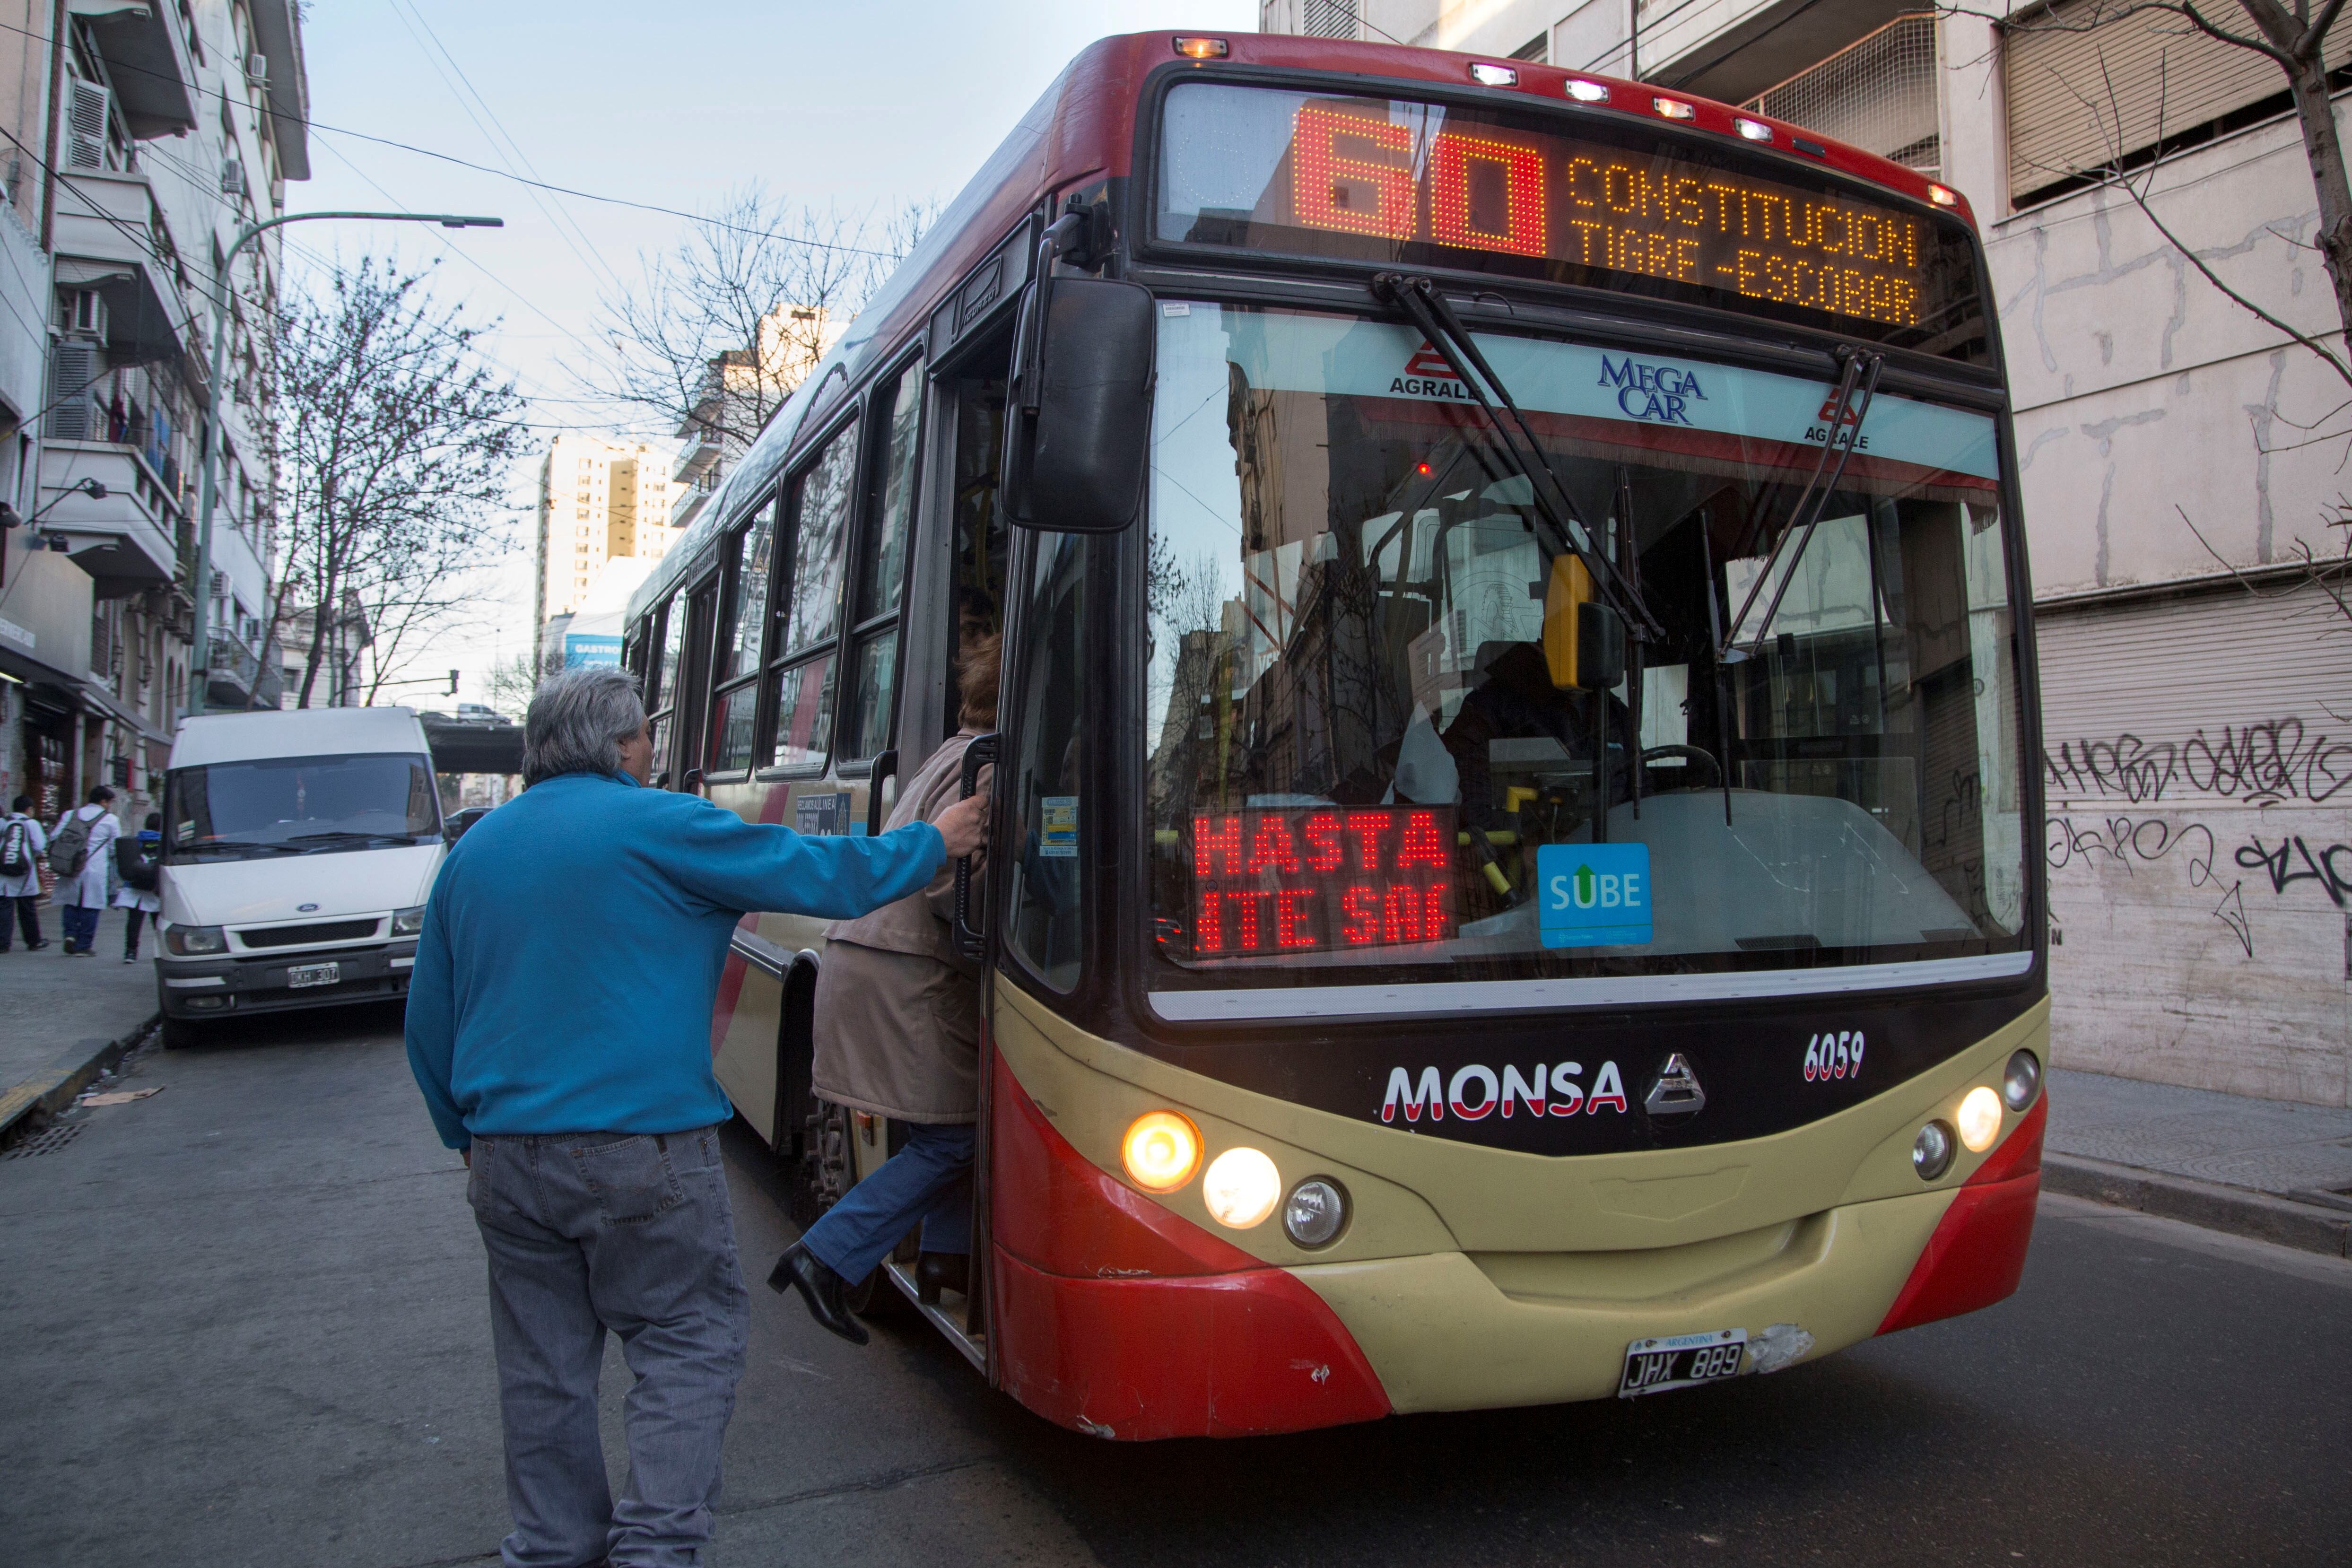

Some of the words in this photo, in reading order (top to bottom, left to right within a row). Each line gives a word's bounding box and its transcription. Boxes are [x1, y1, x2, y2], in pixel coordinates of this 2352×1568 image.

[1292, 107, 1546, 254] 60
[1569, 158, 1917, 267] CONSTITUCION
[1571, 220, 1699, 278] TIGRE
[1597, 354, 1708, 400] MEGA
[1618, 385, 1693, 426] CAR
[575, 644, 621, 654] GASTRO
[819, 798, 835, 810] LINEA
[1195, 813, 1446, 874] HASTA
[1550, 873, 1641, 910] SUBE
[317, 967, 338, 981] 307
[1804, 1030, 1865, 1082] 6059
[1381, 1061, 1628, 1123] MONSA
[1665, 1334, 1713, 1347] ARGENTINA
[1628, 1352, 1680, 1388] JHX
[1690, 1344, 1741, 1379] 889
